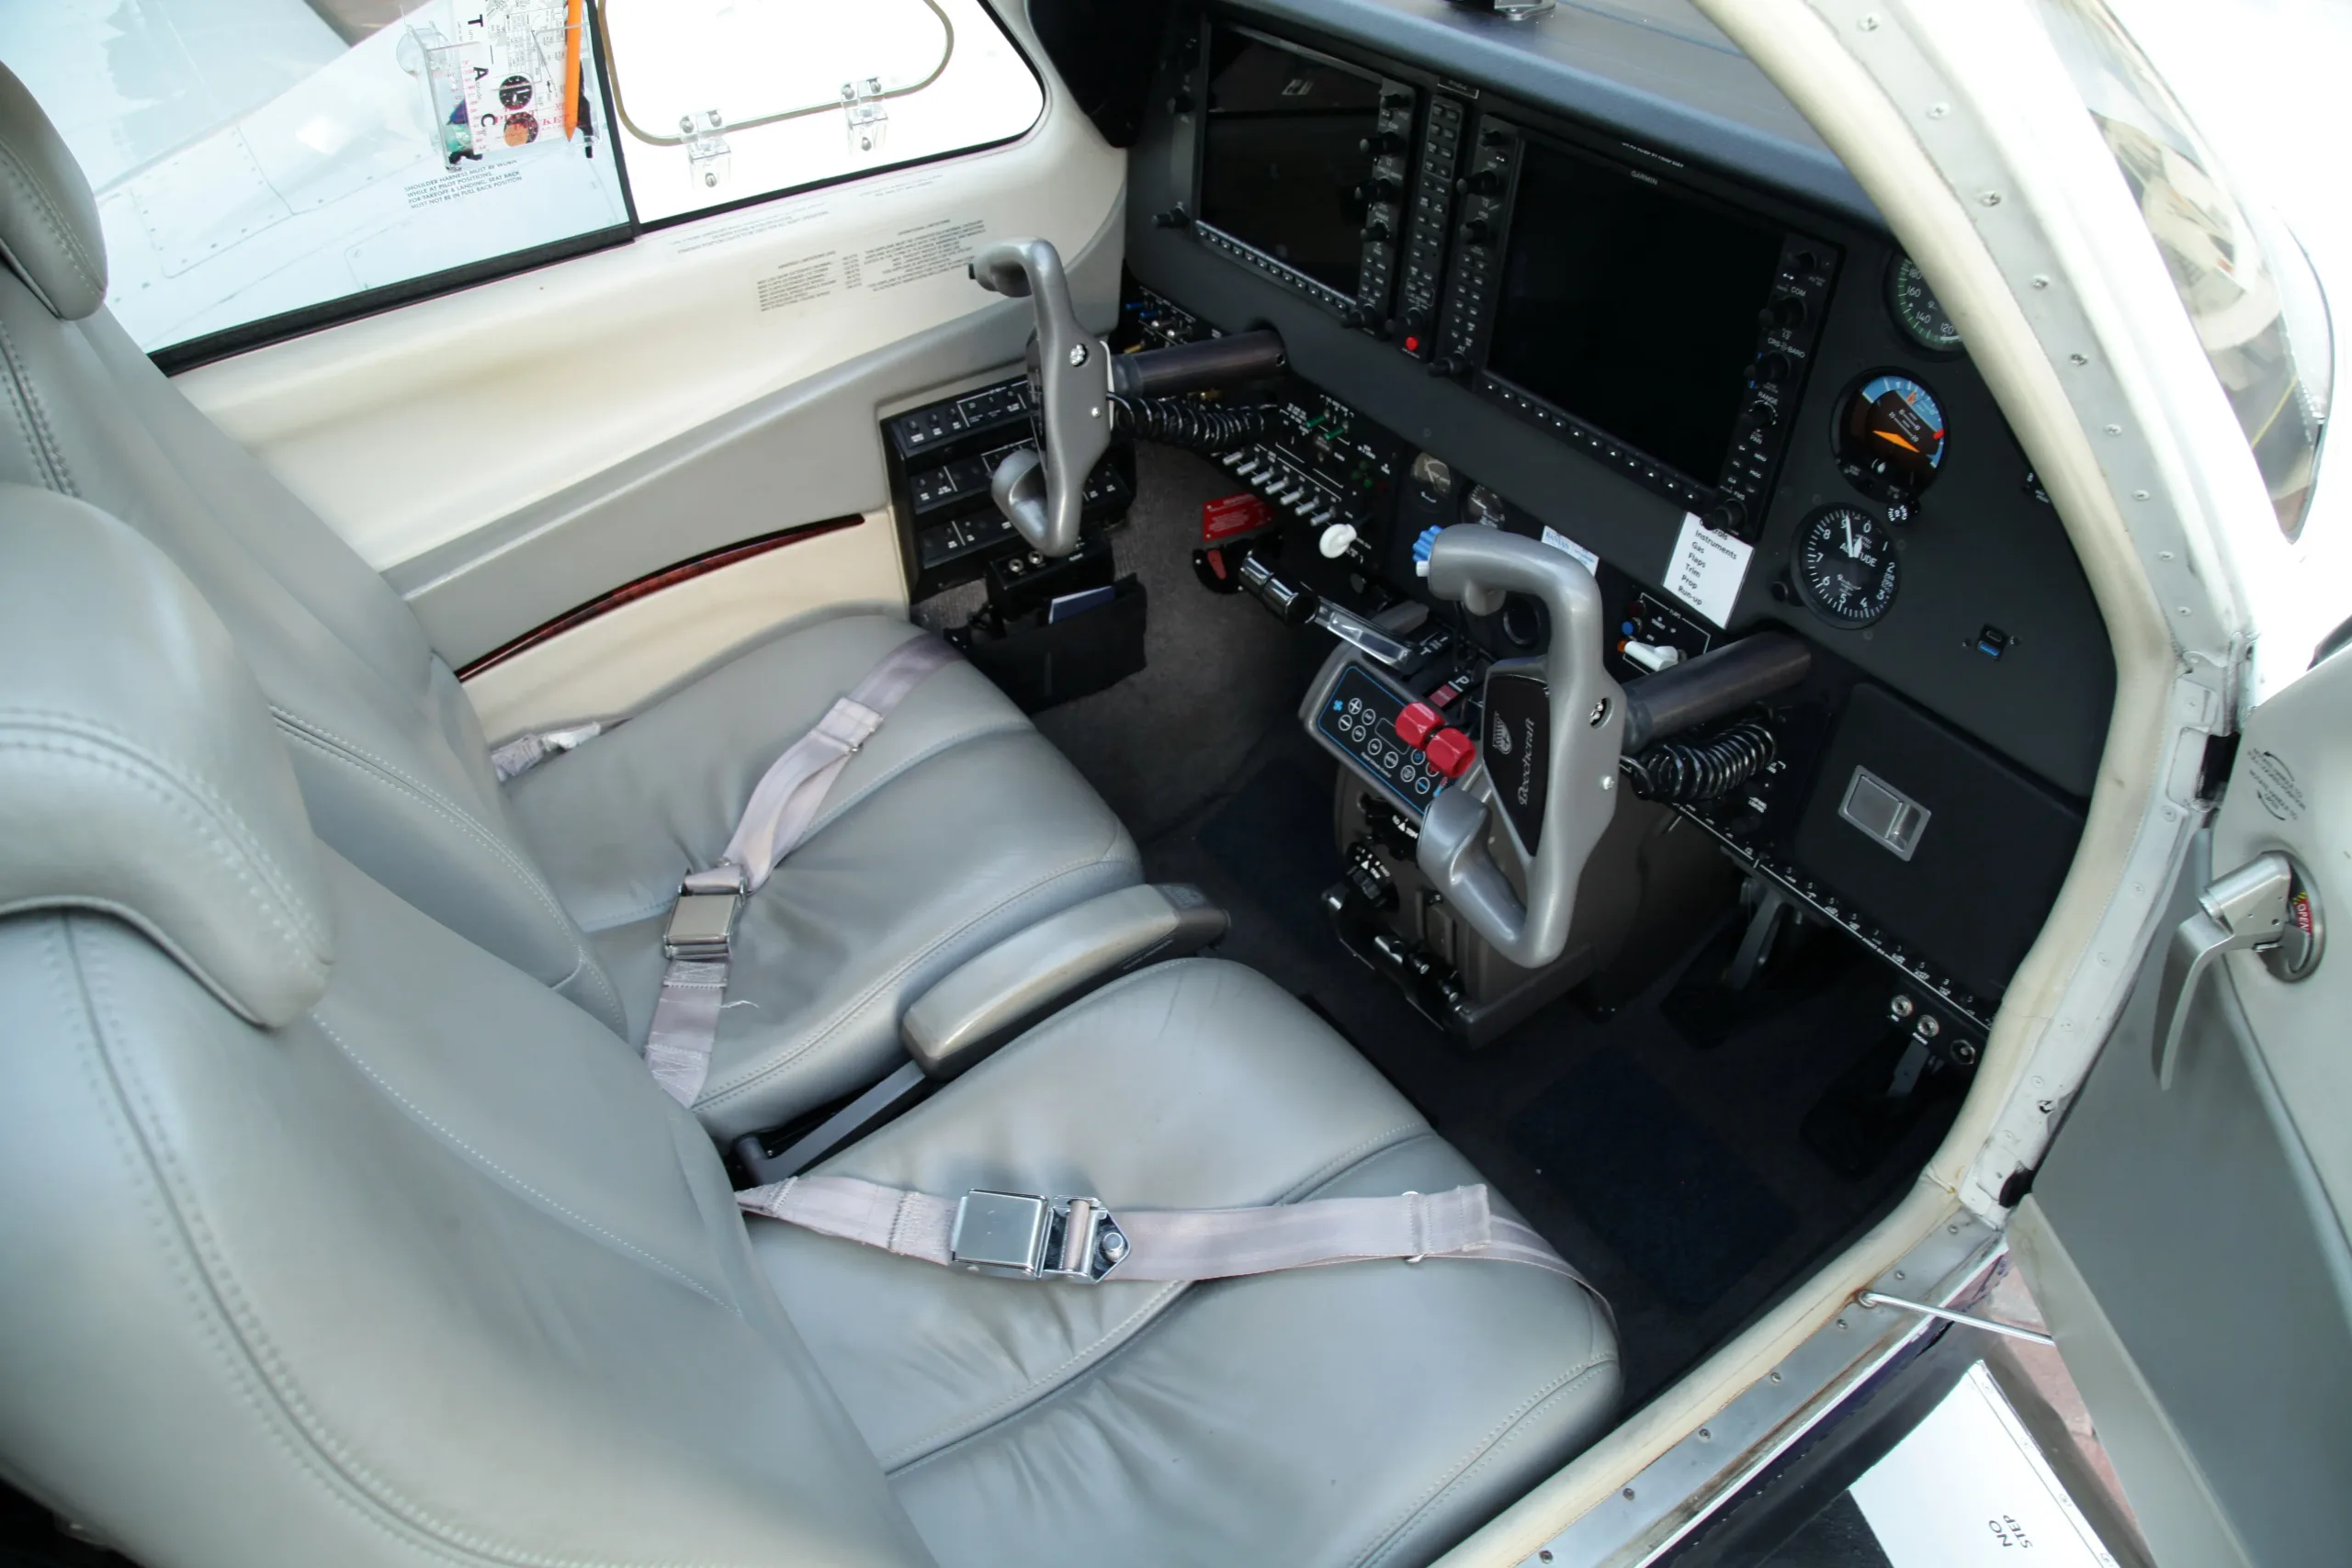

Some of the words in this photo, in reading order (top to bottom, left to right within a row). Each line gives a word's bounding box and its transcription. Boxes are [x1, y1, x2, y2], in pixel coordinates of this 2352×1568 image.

[473, 66, 489, 82] A
[481, 113, 496, 128] C
[404, 179, 439, 192] SHOULDER
[439, 172, 469, 183] HARNESS
[469, 166, 486, 175] MUST
[407, 188, 428, 197] WHILE
[438, 181, 457, 189] PILOT
[458, 171, 492, 184] POSITIONS
[1630, 169, 1658, 186] GARMIN
[409, 196, 422, 204] FOR
[423, 189, 449, 201] TAKEOFF
[488, 175, 503, 183] SEAT
[503, 170, 520, 179] BACK
[411, 201, 428, 209] MUST
[429, 197, 443, 205] NOT
[461, 188, 476, 197] FULL
[493, 175, 523, 188] POSITION
[1908, 267, 1922, 280] 180
[1791, 286, 1807, 297] COM
[1906, 286, 1922, 298] 160
[1916, 310, 1931, 324] 140
[1939, 322, 1954, 335] 120
[1758, 390, 1779, 406] RANGE
[1822, 528, 1832, 540] 8
[1862, 523, 1871, 534] 0
[1691, 541, 1705, 555] Gas
[1694, 529, 1738, 560] Instruments
[1882, 541, 1889, 552] 1
[1688, 552, 1707, 569] Flaps
[1815, 551, 1825, 563] 7
[1685, 563, 1702, 578] Trim
[1886, 561, 1896, 574] 2
[1681, 574, 1699, 590] Prop
[1822, 576, 1831, 586] 6
[1678, 585, 1703, 605] Run-up
[1838, 592, 1848, 604] 5
[1860, 596, 1869, 608] 4
[1876, 588, 1885, 601] 3
[1517, 716, 1536, 807] Beechcraft
[2296, 903, 2310, 933] OPEN
[1988, 1519, 2014, 1548] NO
[2003, 1514, 2034, 1549] STEP
